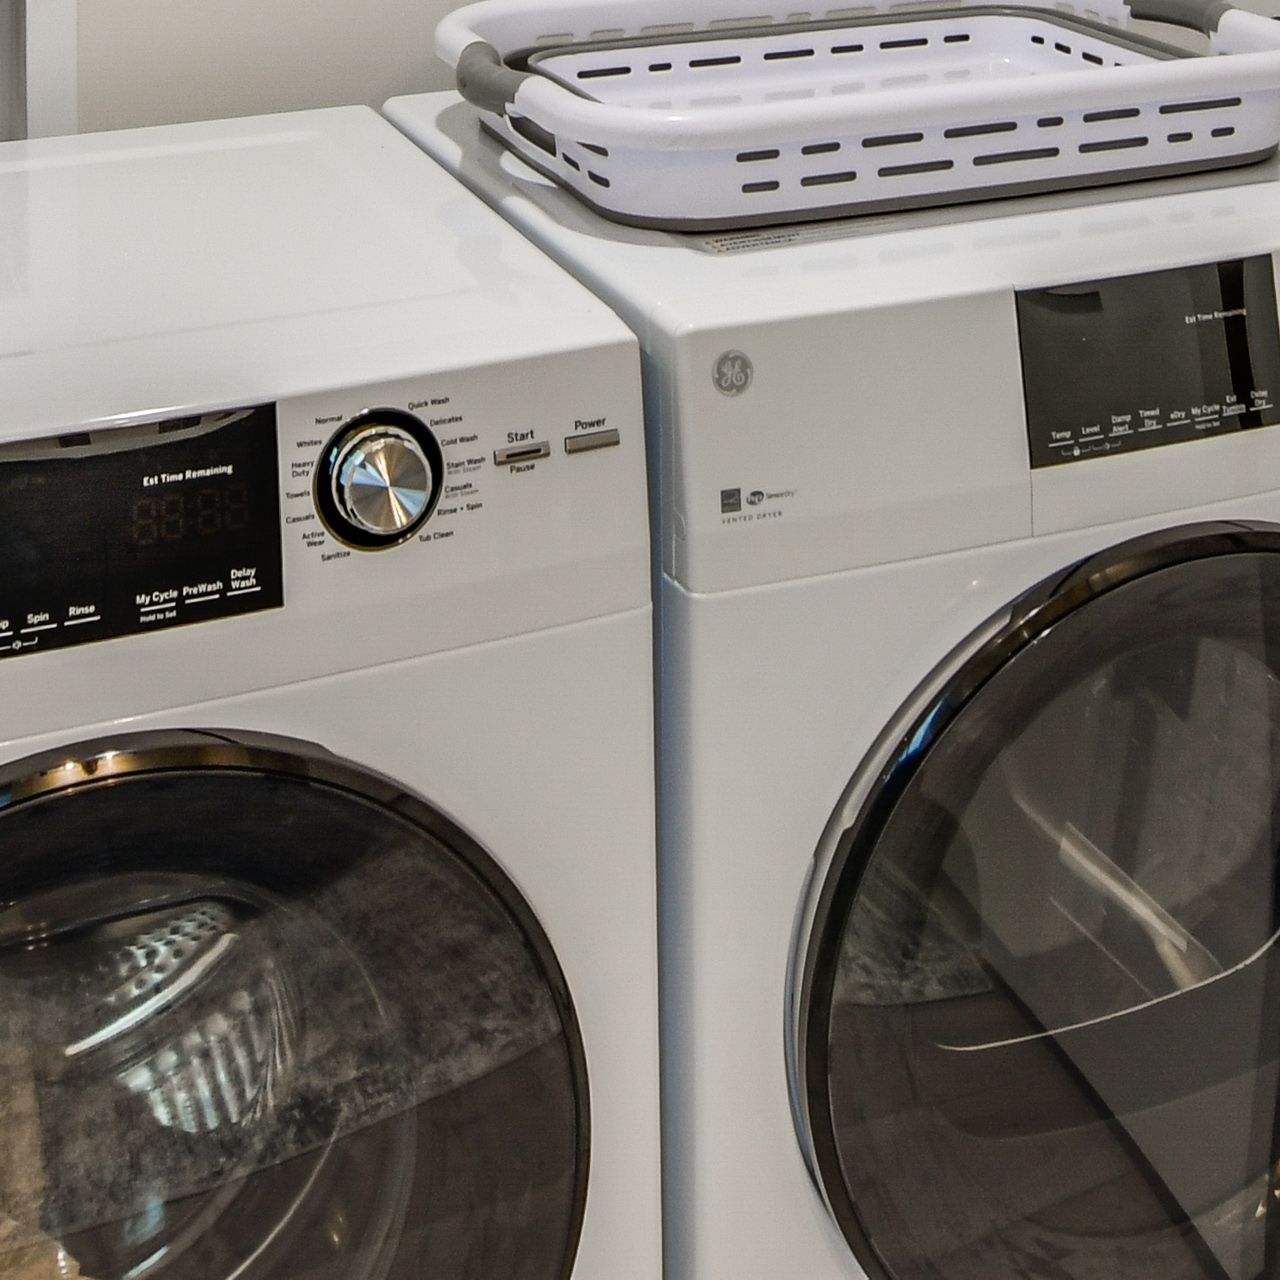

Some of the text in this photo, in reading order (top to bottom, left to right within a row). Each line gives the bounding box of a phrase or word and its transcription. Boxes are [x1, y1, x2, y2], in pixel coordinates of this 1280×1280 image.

[408, 397, 449, 410] Quick Wash
[1139, 409, 1159, 418] Timed
[1191, 404, 1219, 416] My Cycle
[315, 415, 342, 425] Normal
[430, 415, 463, 426] Delicates
[575, 418, 606, 430] Power
[1111, 414, 1131, 423] Damp
[1082, 425, 1100, 434] Level
[1113, 424, 1129, 433] Alert
[441, 434, 478, 447] Cold Wash
[507, 430, 534, 443] Start
[1052, 431, 1071, 440] Temp
[297, 439, 322, 448] Whites
[292, 461, 314, 469] Heavy
[447, 457, 486, 469] Stain Wash
[510, 463, 535, 474] Pause
[143, 465, 233, 487] Est Time Remaining
[292, 470, 309, 478] Duty
[445, 482, 472, 493] Casuals
[286, 491, 310, 499] Towels
[437, 507, 457, 516] Rinse
[467, 502, 482, 513] Spin
[286, 514, 314, 524] Casuals
[302, 531, 325, 540] Active
[419, 530, 453, 542] Tub Clean
[321, 551, 350, 561] Sanitize
[231, 568, 256, 578] Delay
[183, 581, 223, 596] PreWash
[231, 577, 256, 589] Wash
[136, 589, 178, 604] My Cycle
[69, 605, 95, 616] Rinse
[27, 613, 49, 624] Spin
